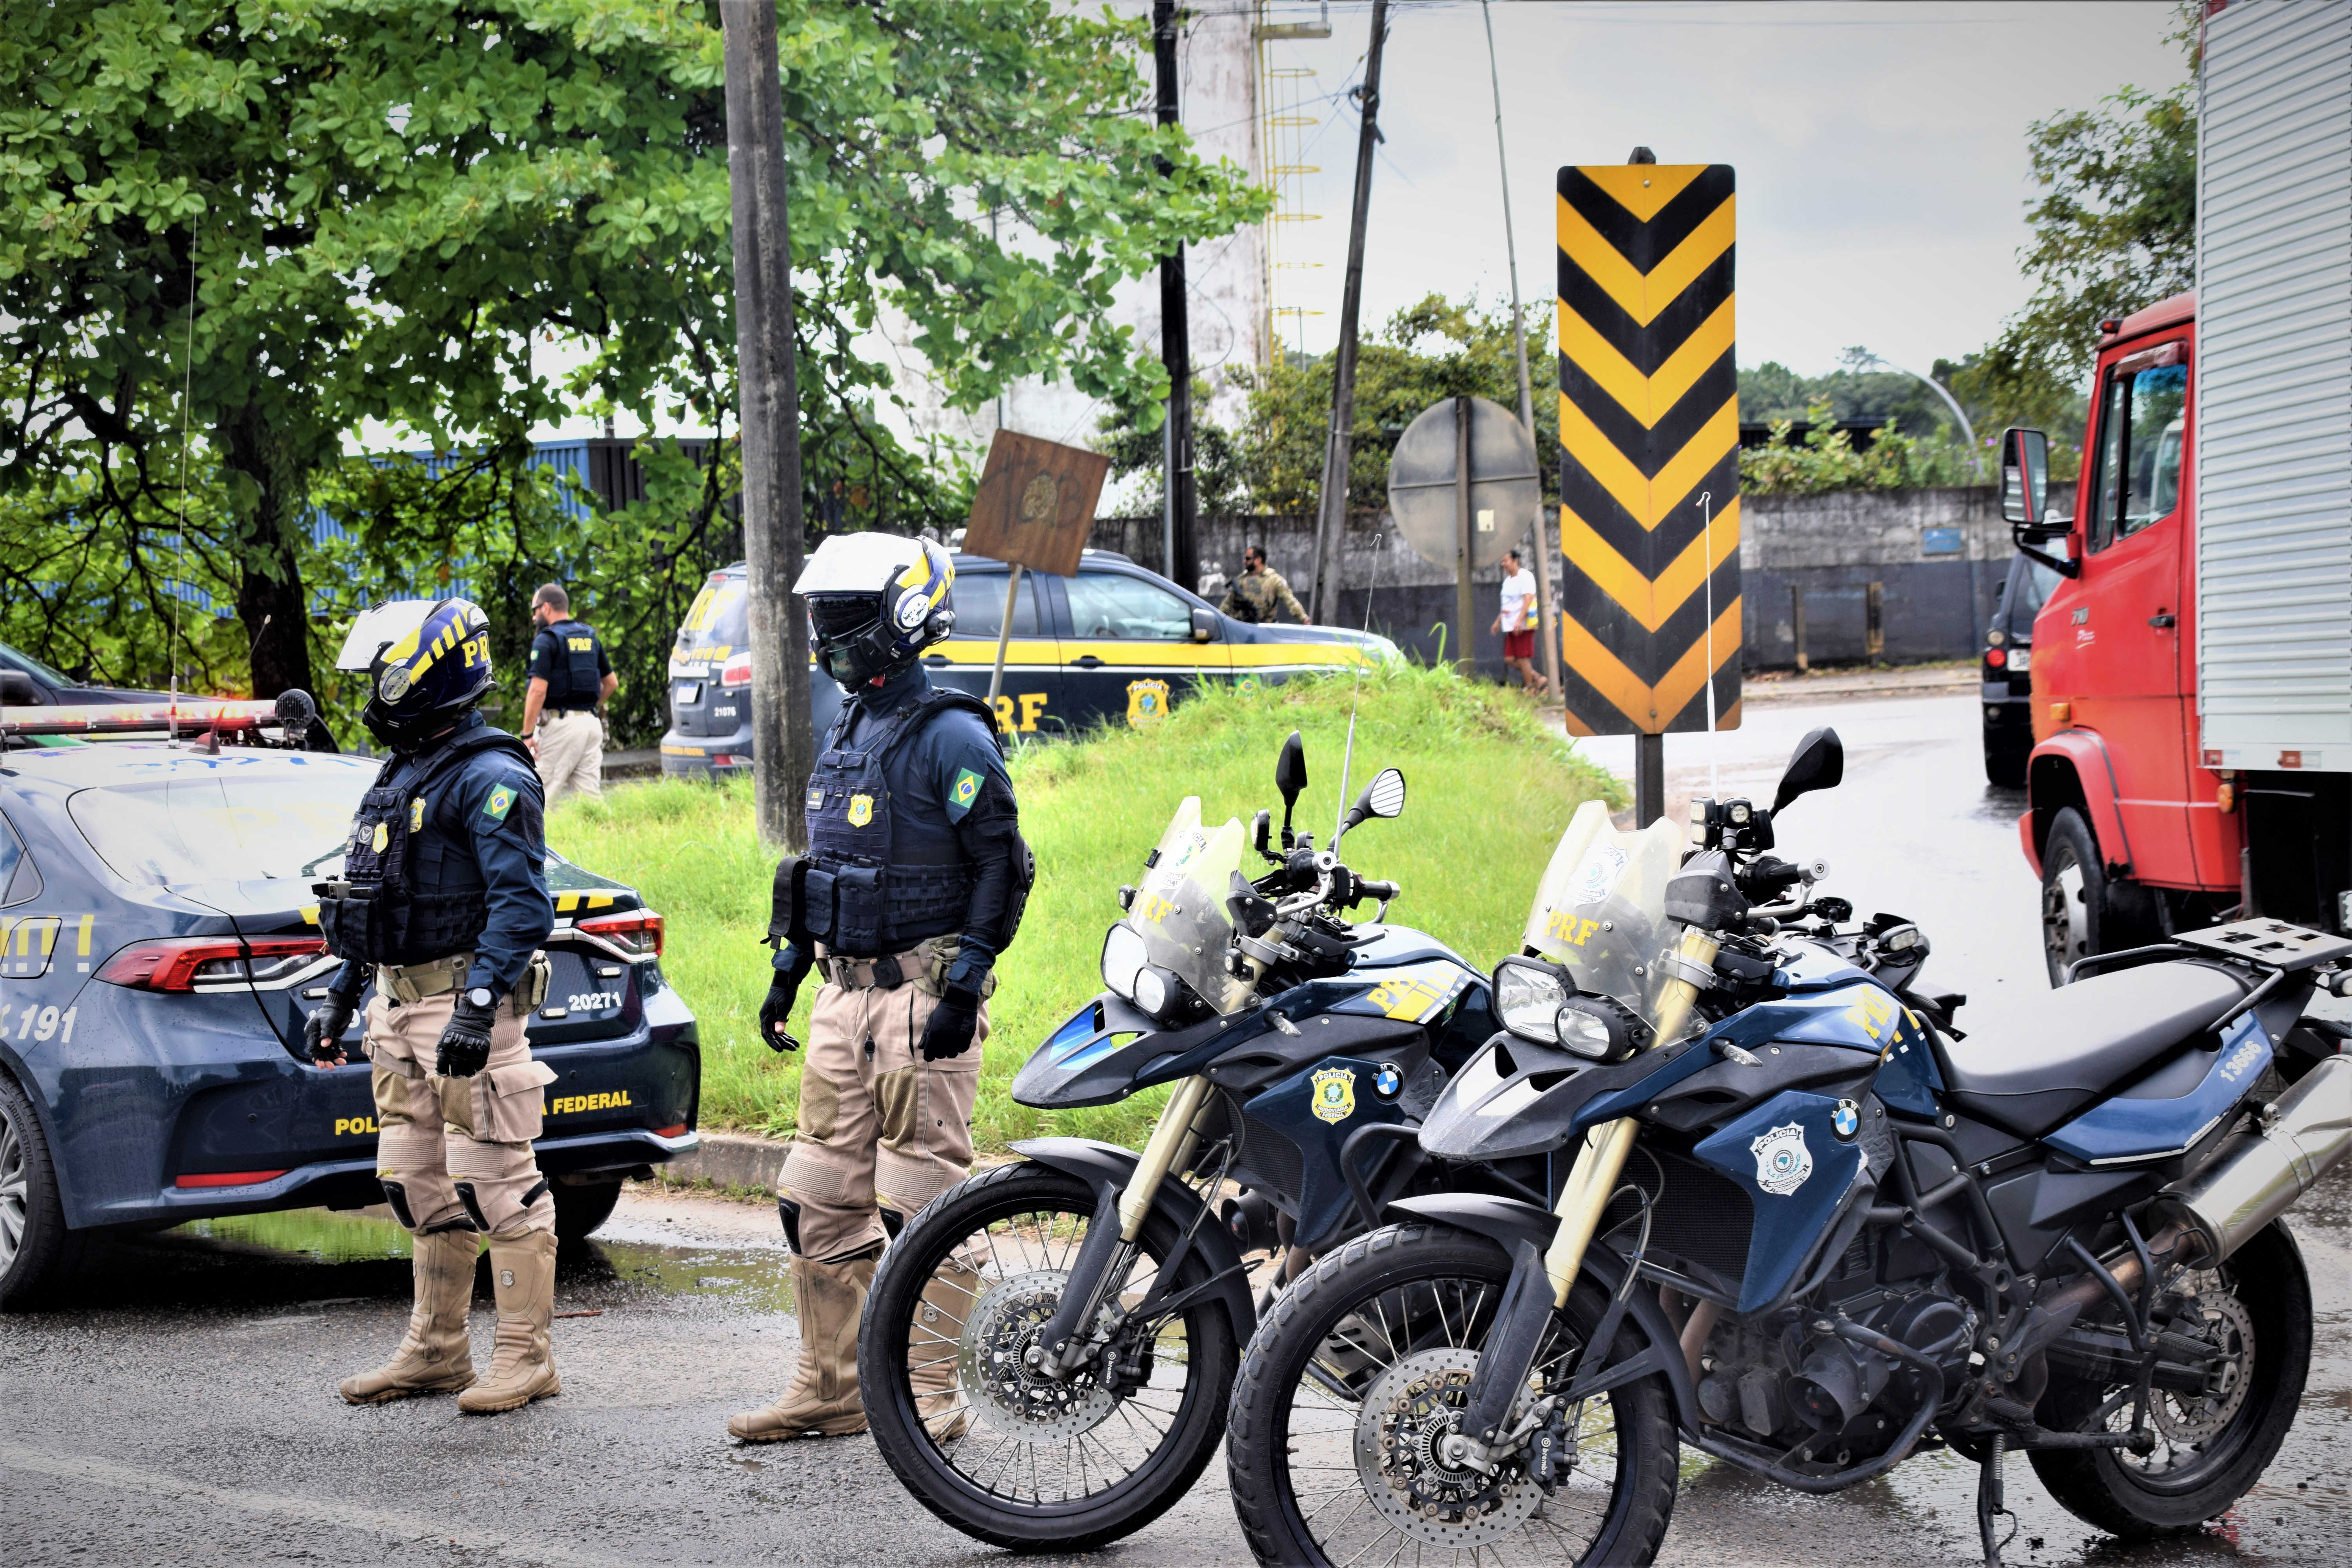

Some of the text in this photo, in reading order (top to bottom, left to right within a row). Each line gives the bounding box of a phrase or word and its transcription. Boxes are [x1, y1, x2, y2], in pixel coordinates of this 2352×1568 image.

[568, 638, 592, 651] PRF
[714, 706, 737, 717] 21076
[1543, 910, 1599, 946] PRF
[568, 991, 622, 1011] 20271
[17, 1004, 78, 1043] 191
[2220, 1040, 2262, 1082] 13666
[1372, 1065, 1399, 1081] BMW
[553, 1090, 632, 1114] FEDERAL
[1831, 1100, 1858, 1119] BMW
